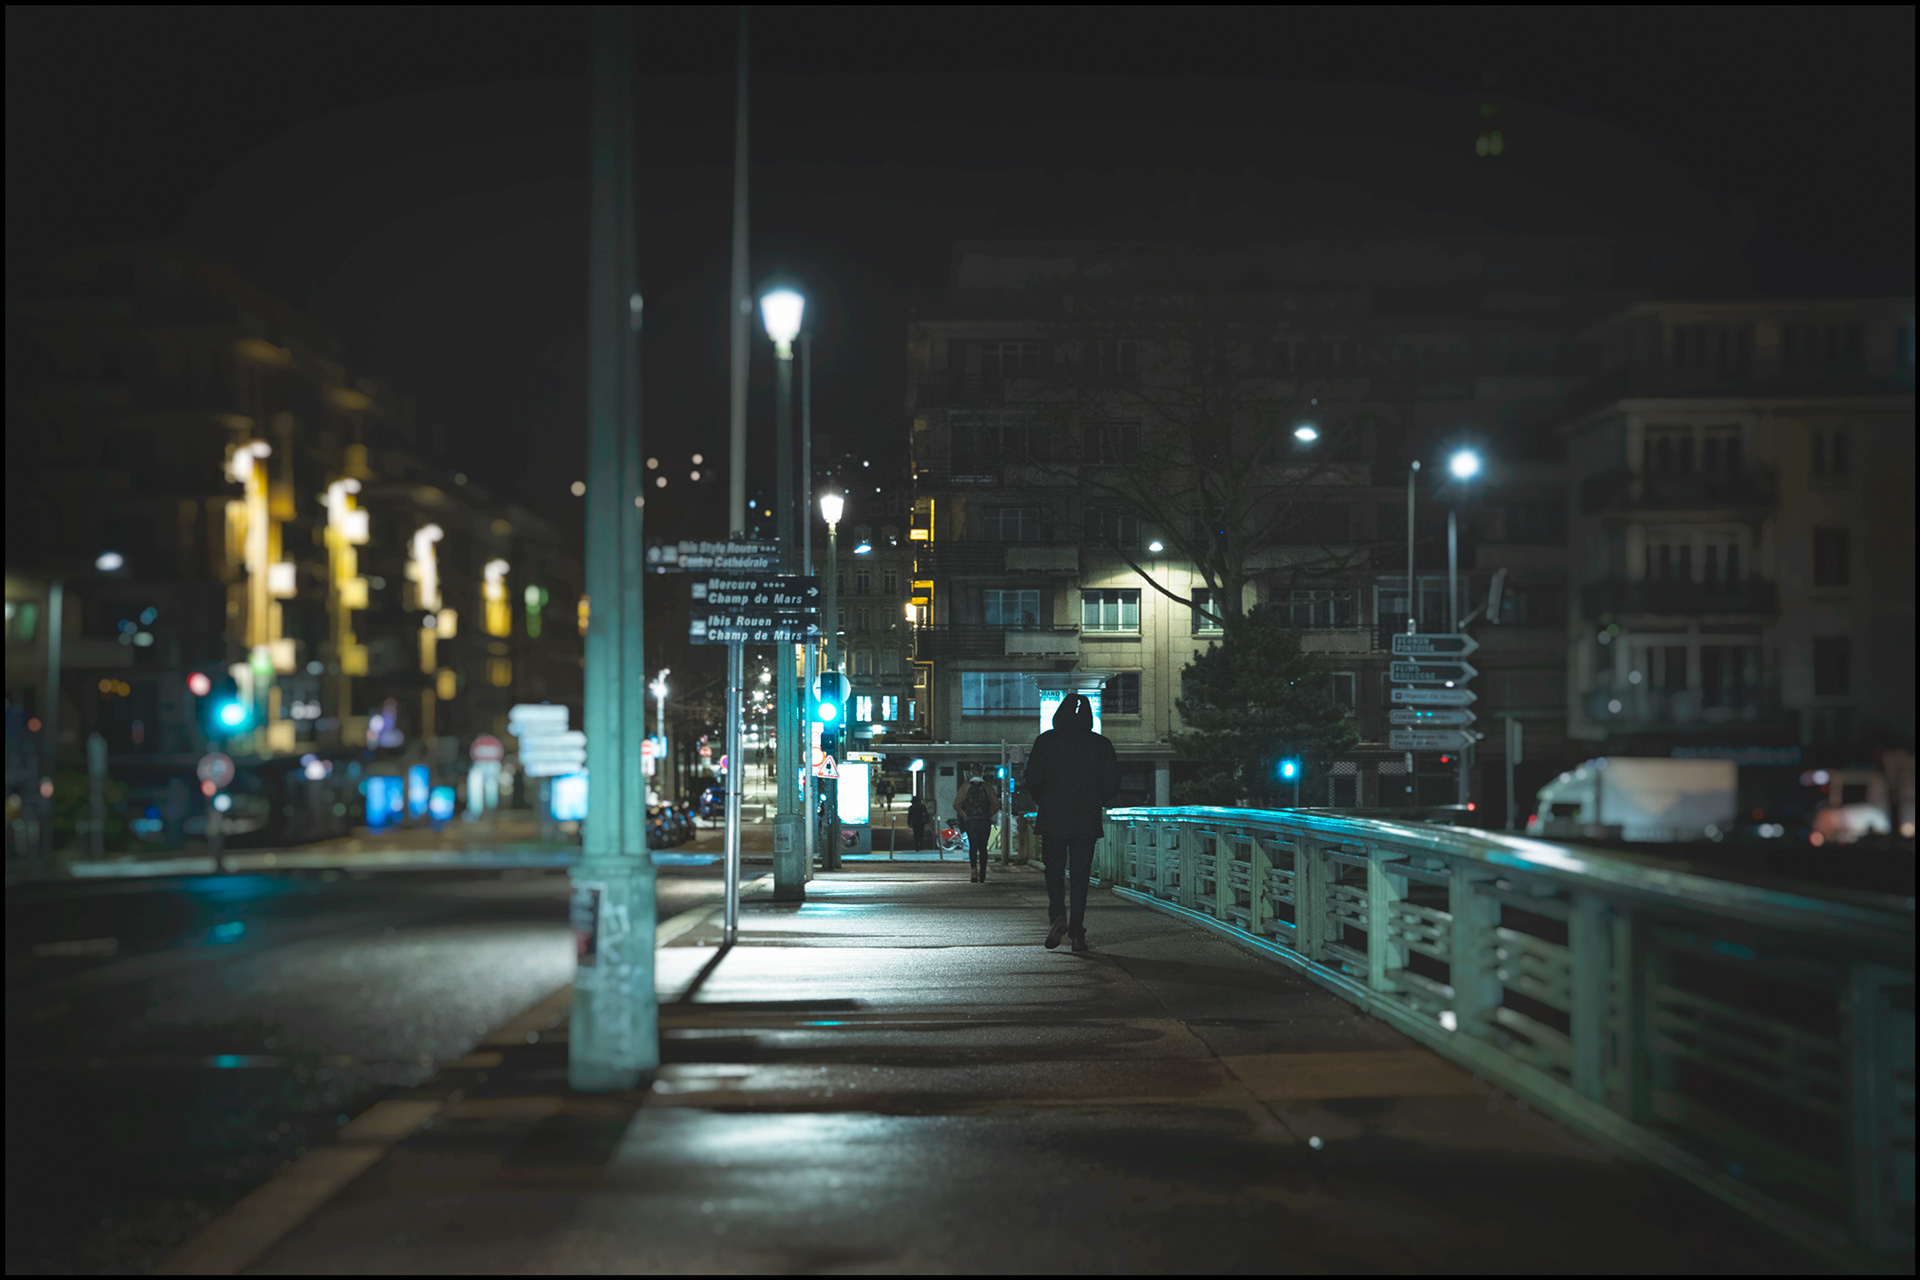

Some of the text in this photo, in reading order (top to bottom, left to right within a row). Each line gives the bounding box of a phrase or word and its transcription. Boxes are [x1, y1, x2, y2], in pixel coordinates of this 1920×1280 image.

[727, 541, 758, 554] Rouen
[714, 555, 768, 568] Cathédrale
[708, 578, 757, 590] Mercure
[708, 593, 802, 606] Champ de Mars
[708, 615, 772, 626] Ibis Rouen
[708, 629, 802, 642] Champ de Mars
